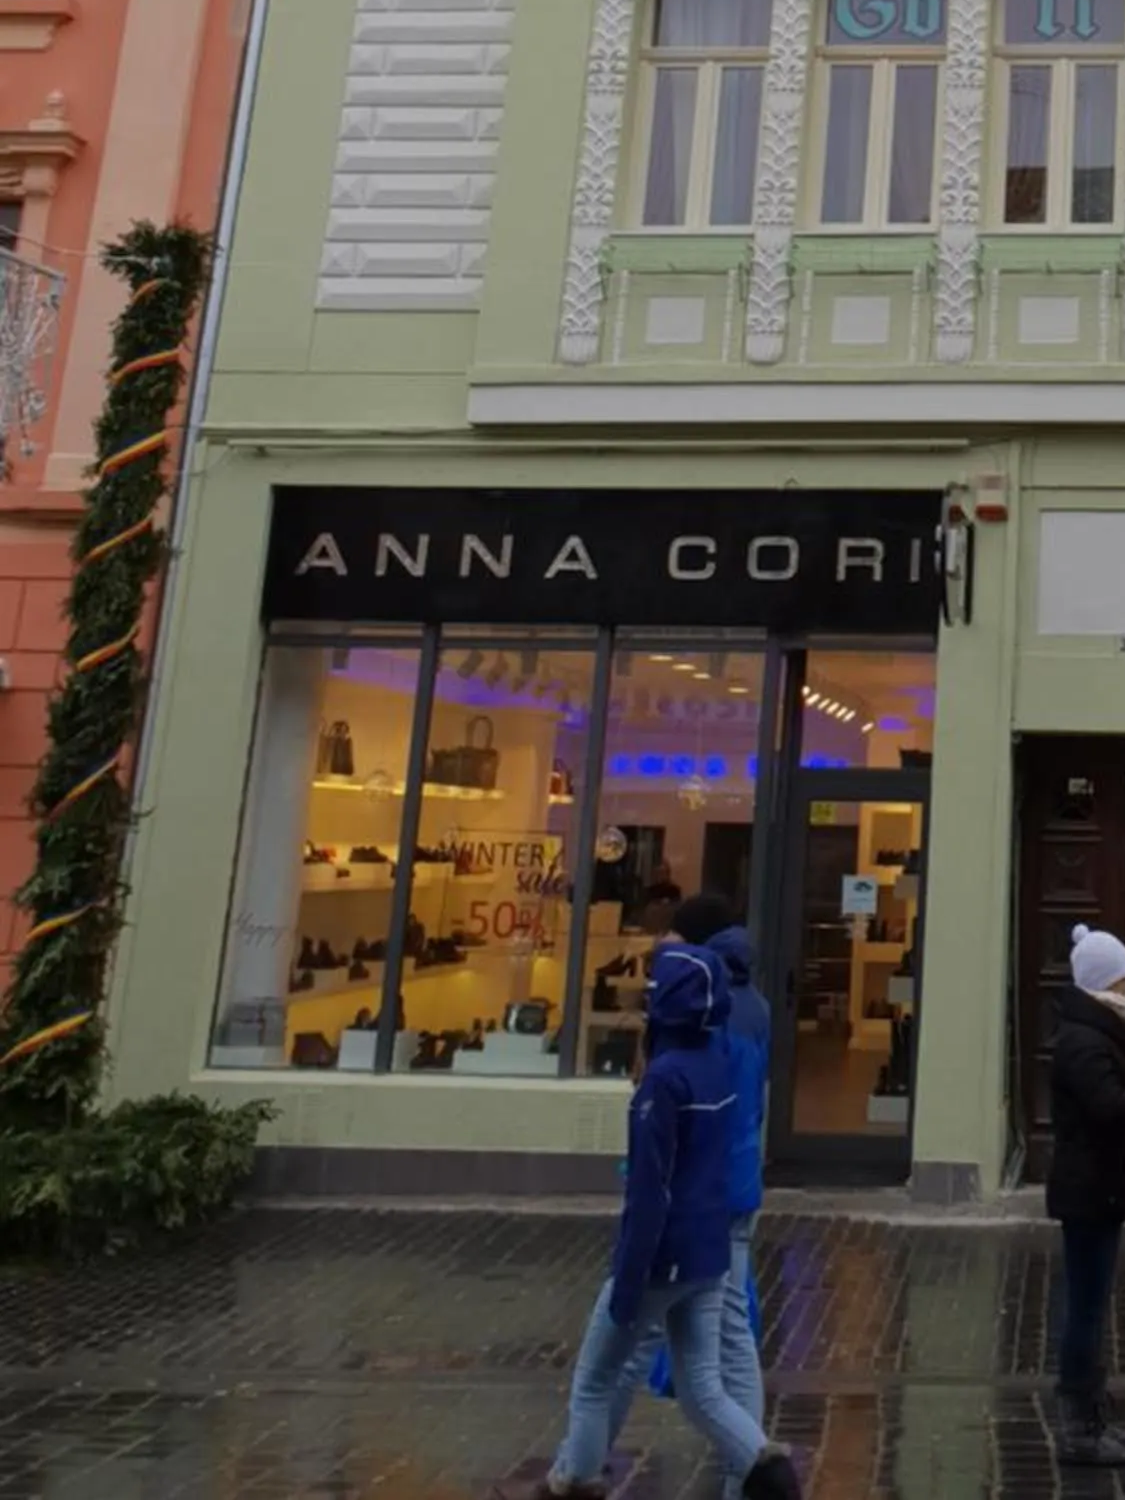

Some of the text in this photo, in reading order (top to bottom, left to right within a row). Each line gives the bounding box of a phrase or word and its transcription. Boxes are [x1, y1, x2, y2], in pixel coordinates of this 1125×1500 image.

[294, 532, 922, 583] ANNA CORI
[439, 839, 545, 868] WINTER
